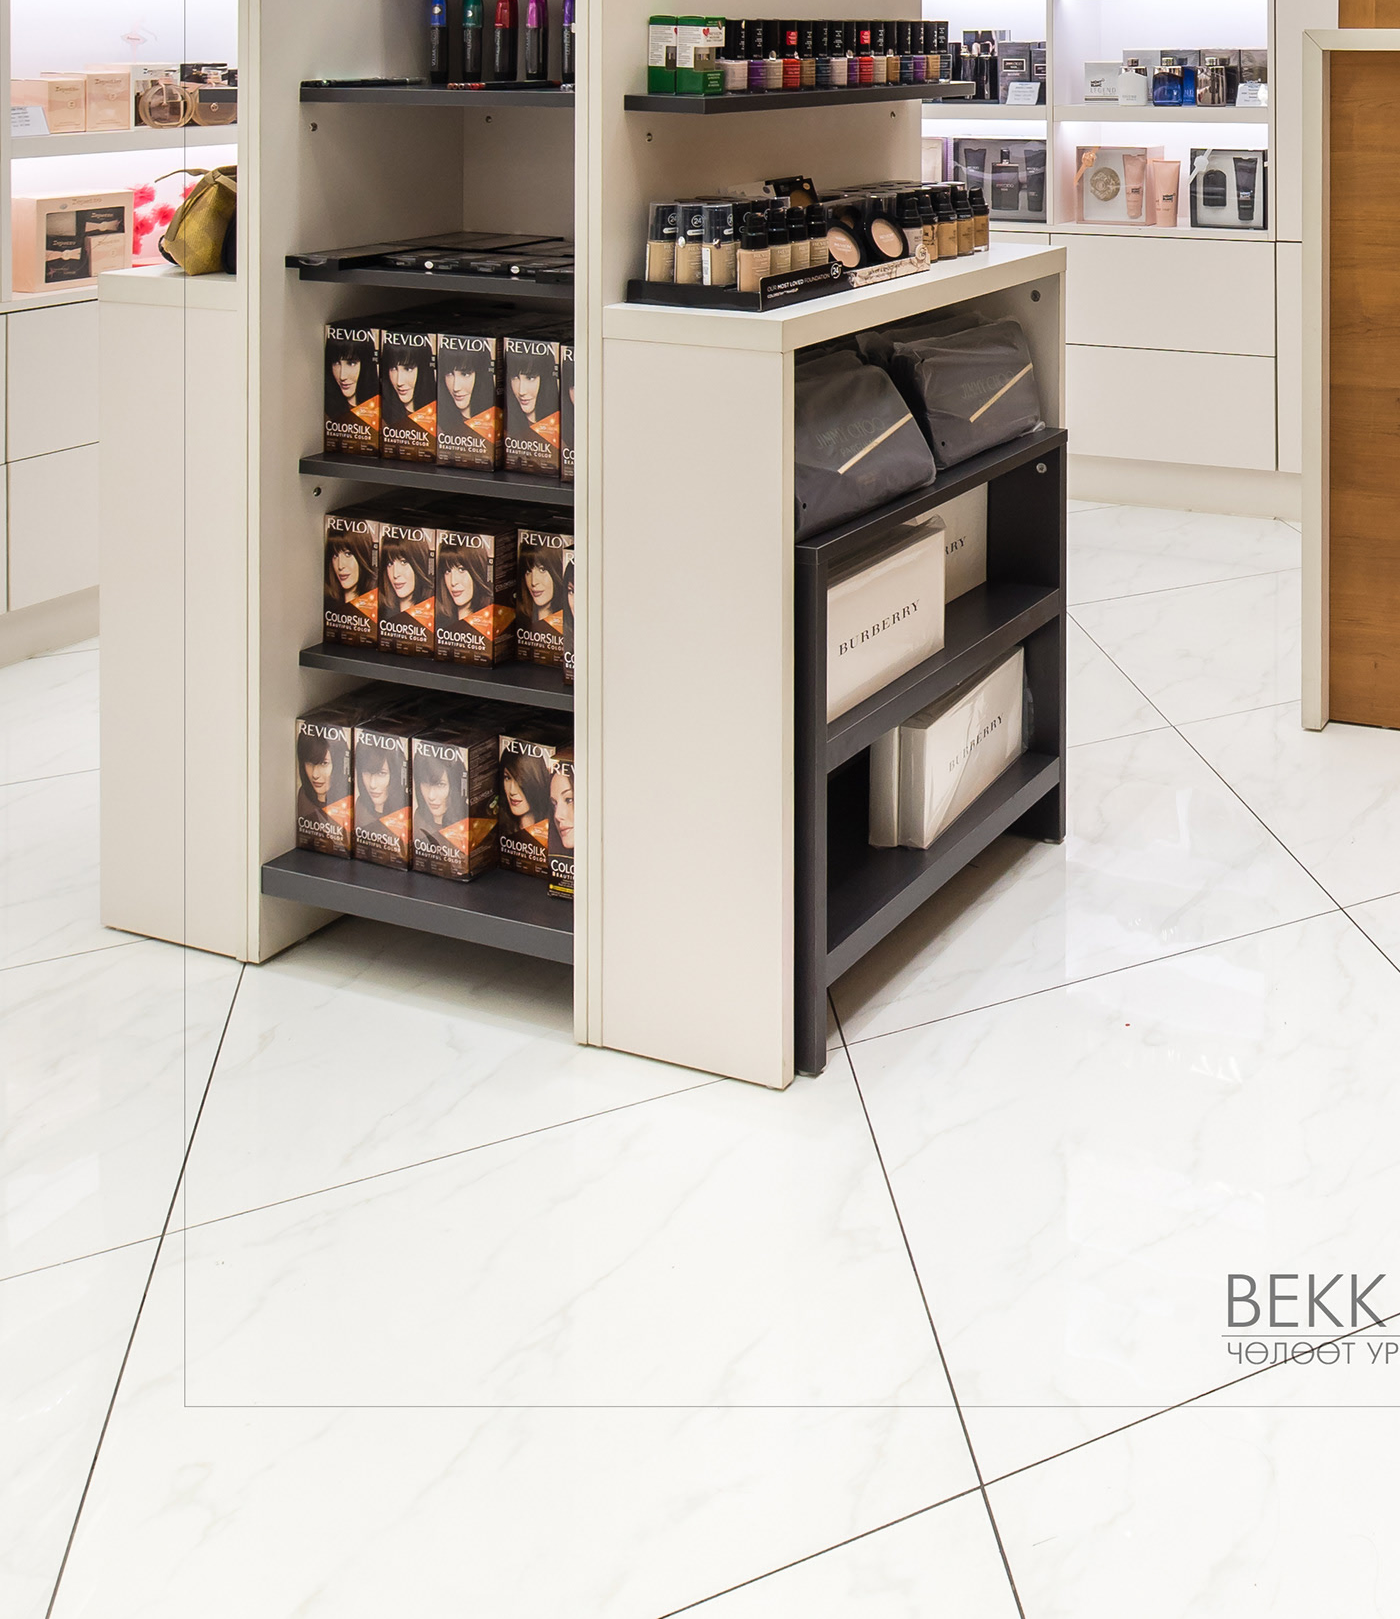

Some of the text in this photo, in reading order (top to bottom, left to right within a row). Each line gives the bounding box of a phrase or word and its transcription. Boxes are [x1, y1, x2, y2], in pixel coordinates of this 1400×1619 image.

[327, 327, 375, 343] REVLON
[383, 333, 432, 348] REVLON
[440, 337, 491, 353] REVLON
[506, 340, 557, 356] REVLON
[439, 532, 491, 550] REVLON
[839, 599, 919, 656] BURBERRY
[356, 731, 405, 752] REVLON
[949, 713, 1004, 772] BURBERRY
[415, 742, 465, 762] REVLON
